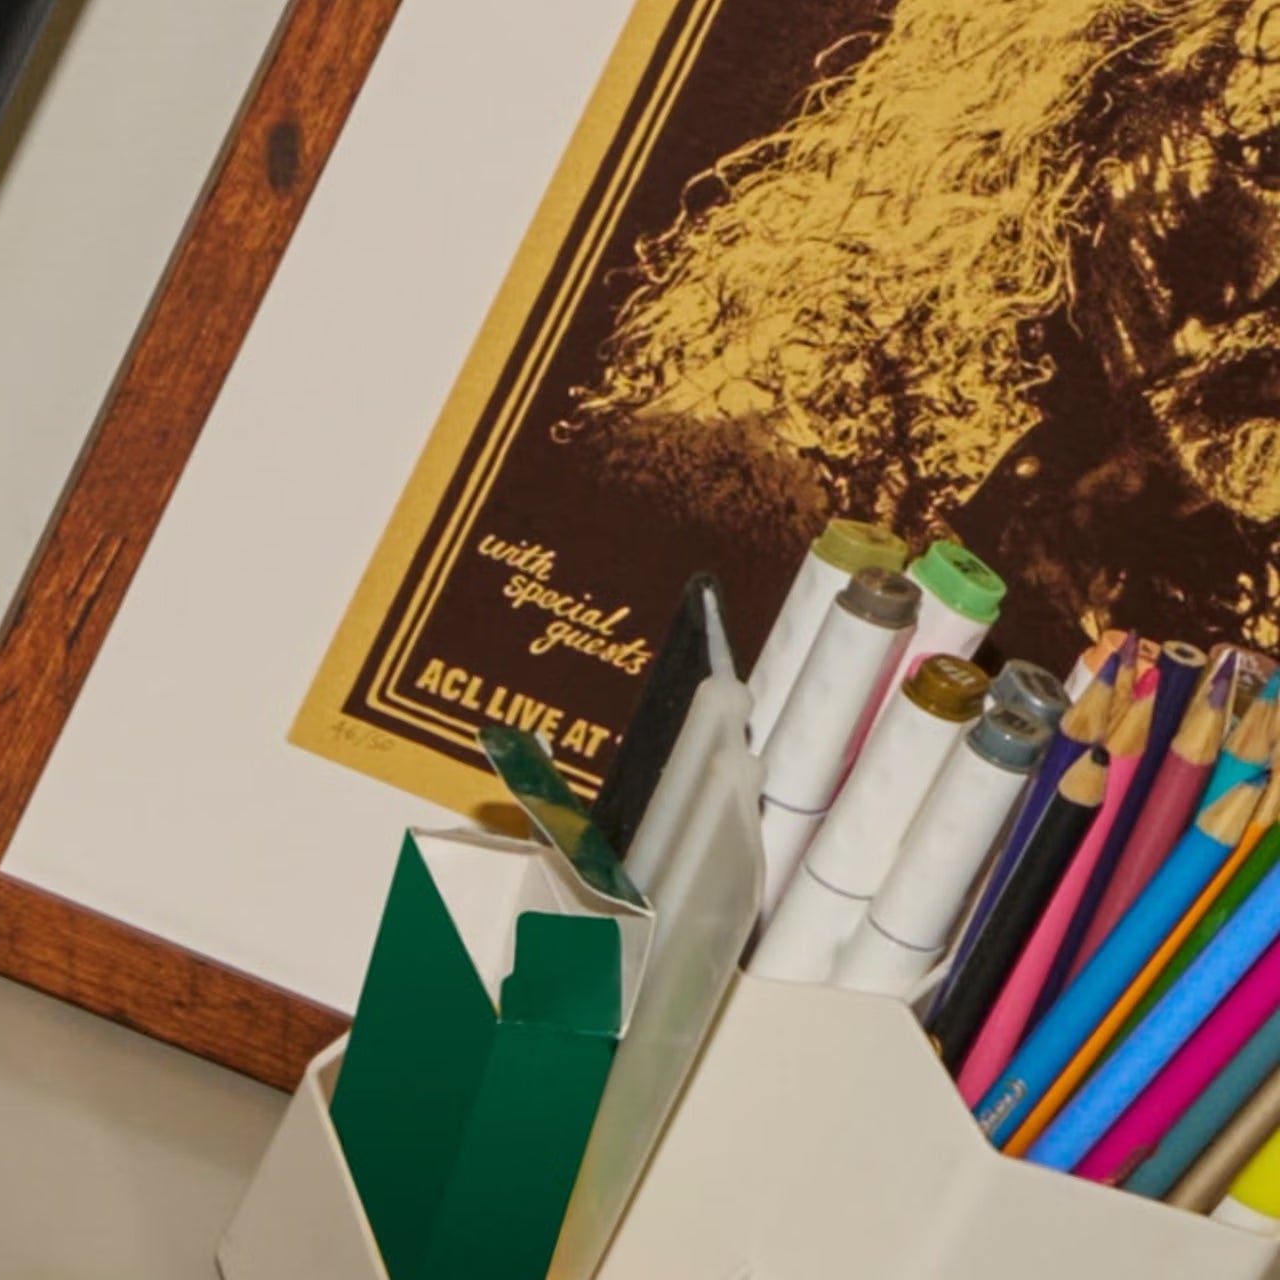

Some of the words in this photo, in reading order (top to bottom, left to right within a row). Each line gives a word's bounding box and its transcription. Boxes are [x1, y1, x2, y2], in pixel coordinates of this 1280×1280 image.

[478, 534, 556, 581] with
[503, 574, 631, 635] special
[529, 620, 654, 675] guests
[415, 658, 484, 710] ACL
[485, 686, 564, 742] LIVE
[560, 719, 611, 757] AT
